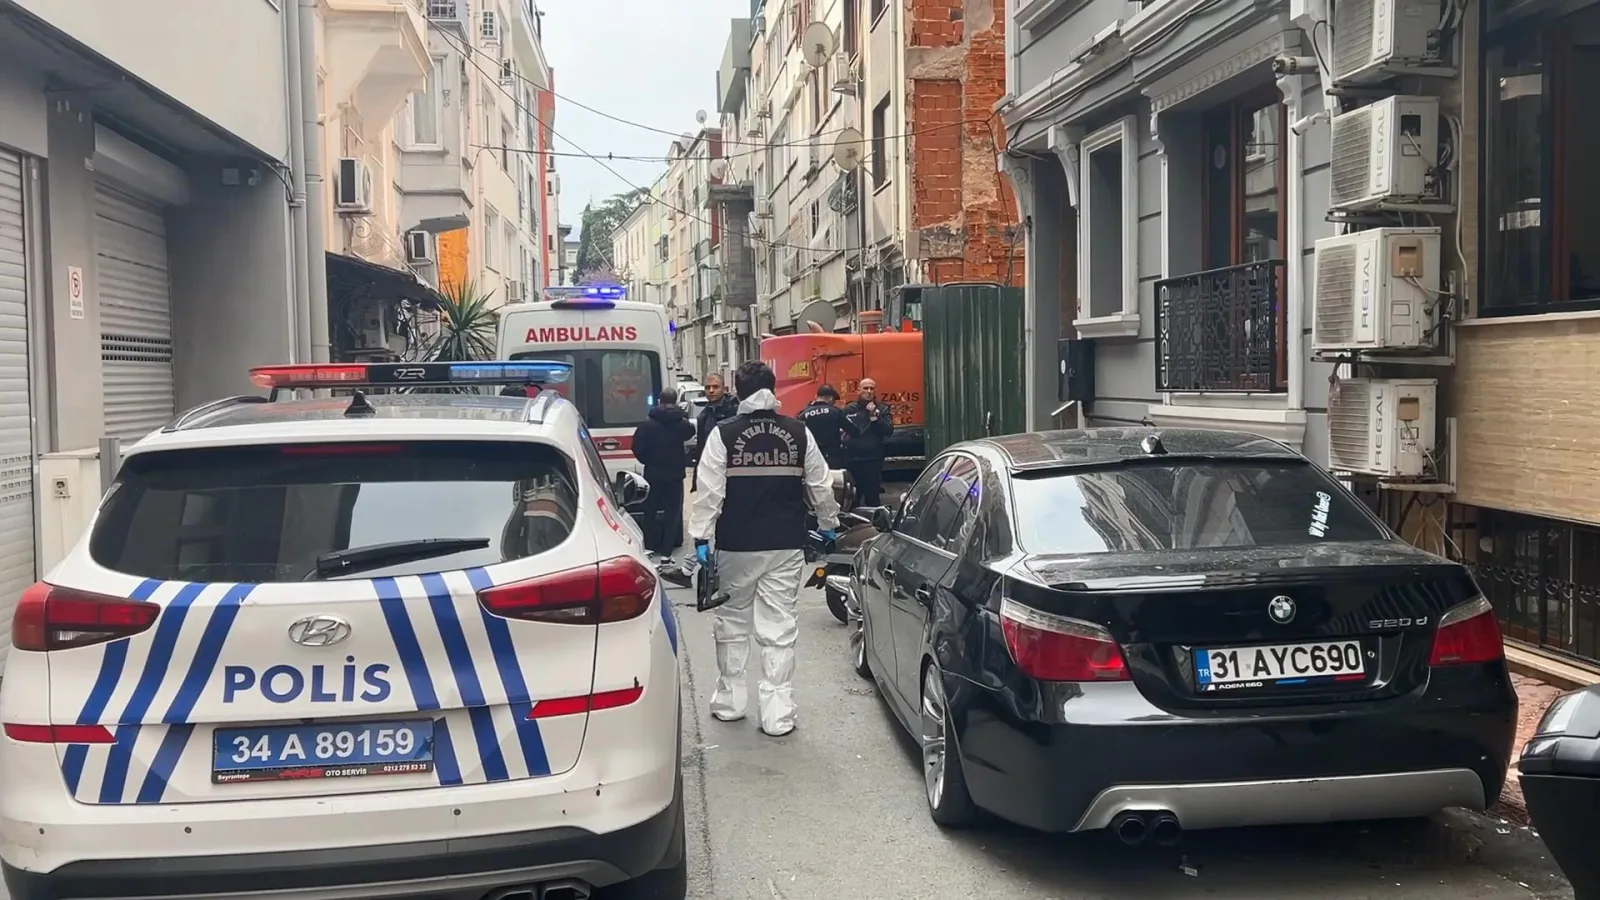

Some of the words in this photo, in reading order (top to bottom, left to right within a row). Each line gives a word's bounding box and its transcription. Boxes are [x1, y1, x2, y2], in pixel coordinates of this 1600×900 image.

[1375, 107, 1385, 188] REGAL
[1361, 248, 1372, 328] REGAL
[525, 326, 638, 343] AMBULANS
[881, 391, 920, 402] ZAXIS
[732, 436, 747, 466] OLAY
[742, 422, 766, 439] YERİ
[1375, 388, 1384, 466] REGAL
[743, 448, 789, 466] POLİS
[1198, 668, 1210, 678] TR
[1211, 650, 1241, 679] 31
[1252, 643, 1361, 677] AYC690
[223, 655, 391, 704] POLİS
[232, 734, 272, 764] 34
[279, 733, 306, 761] A
[315, 728, 415, 759] 89159
[325, 769, 341, 777] OTO
